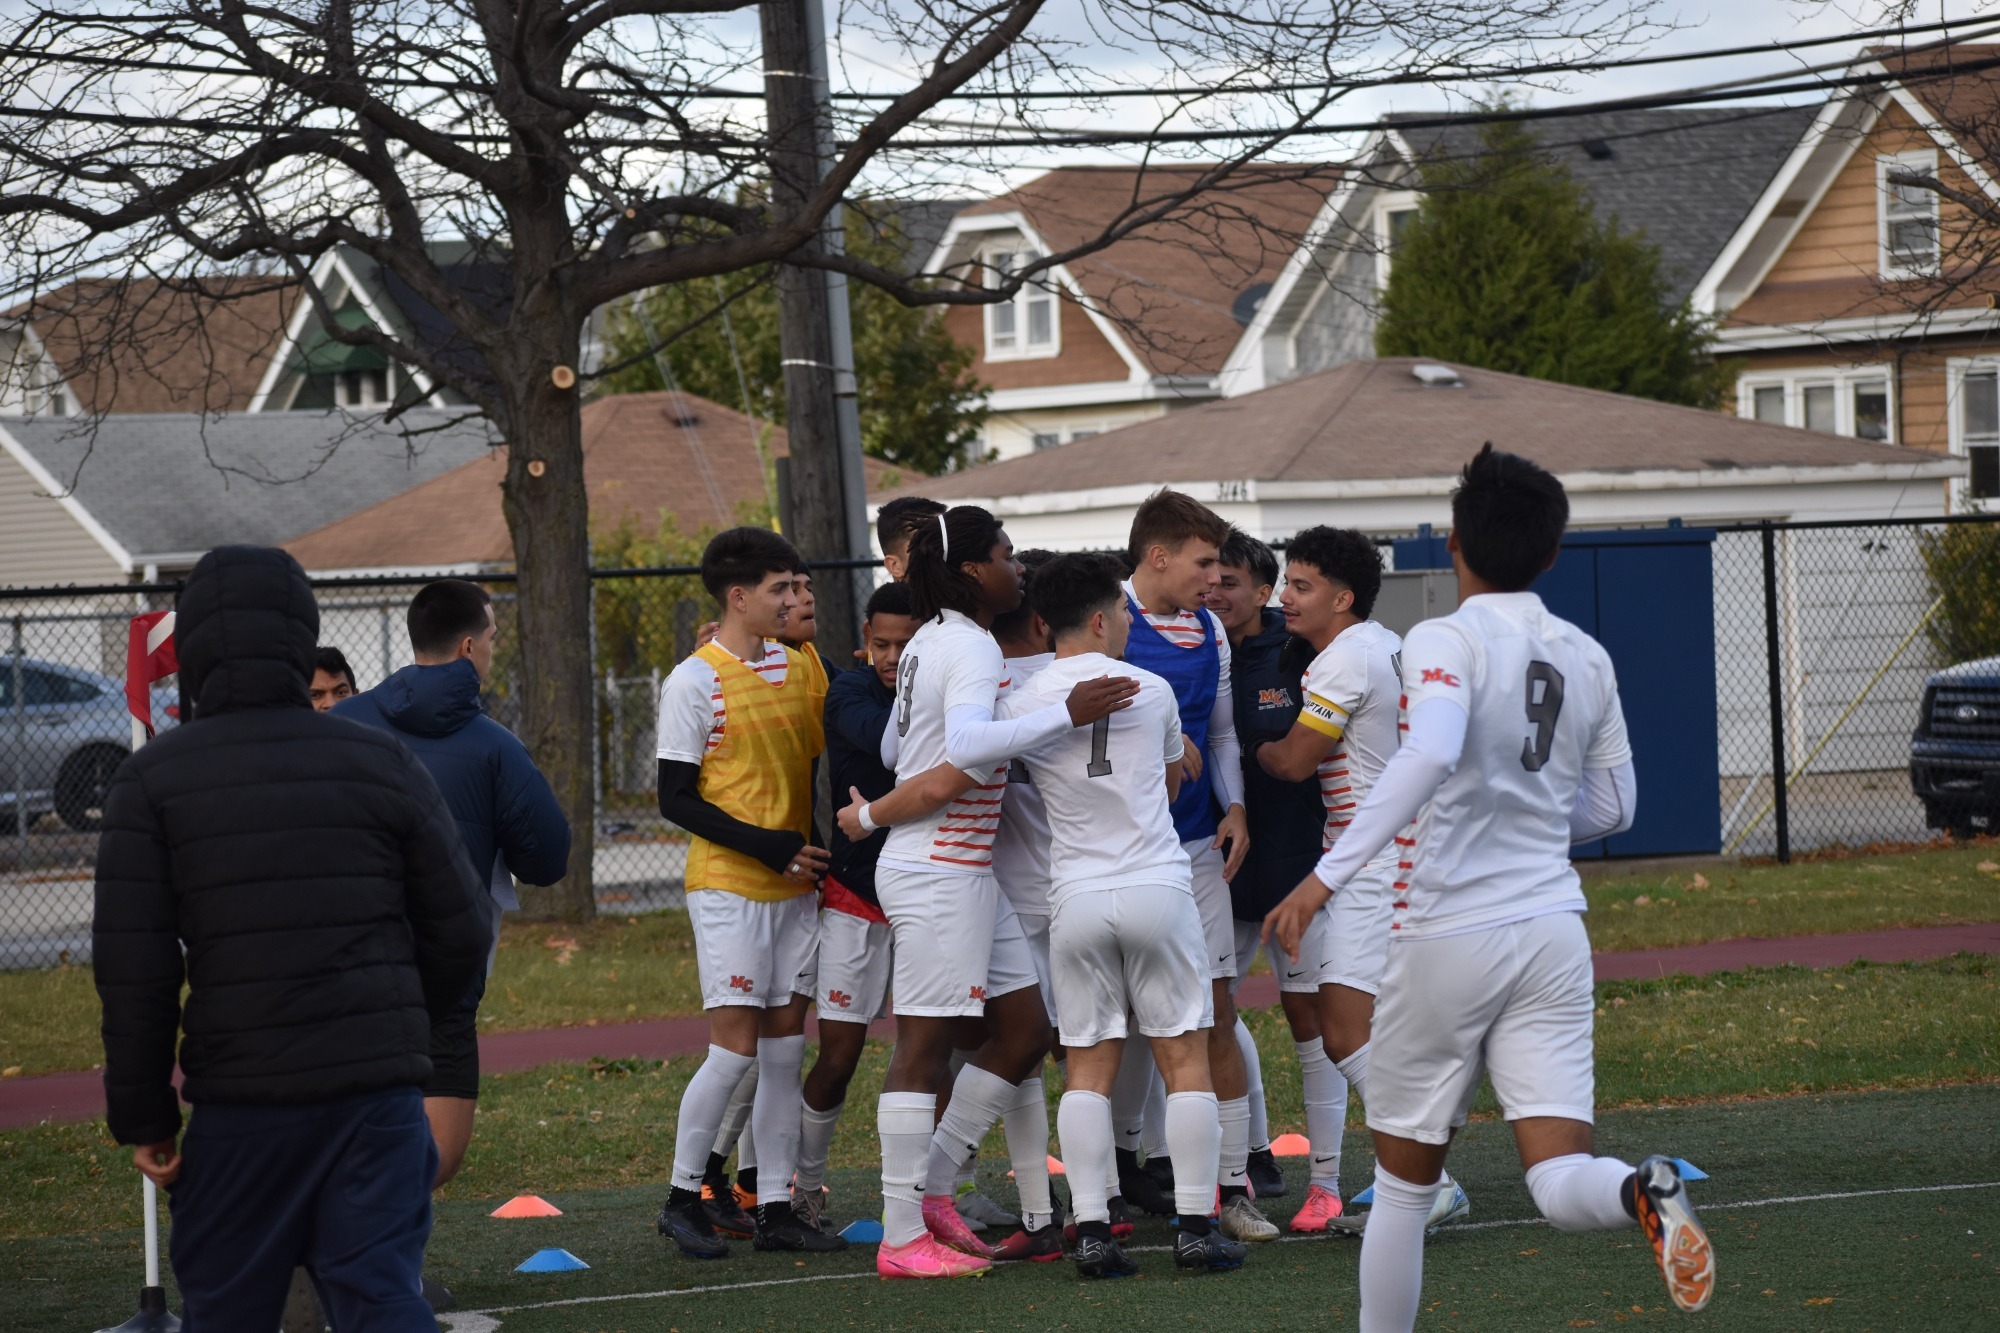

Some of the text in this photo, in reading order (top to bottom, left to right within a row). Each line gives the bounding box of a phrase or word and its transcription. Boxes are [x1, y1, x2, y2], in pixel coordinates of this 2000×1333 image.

[1421, 667, 1461, 688] MC
[1520, 660, 1565, 771] 9
[730, 975, 754, 993] MC
[828, 990, 852, 1008] MC
[969, 985, 987, 1004] MC
